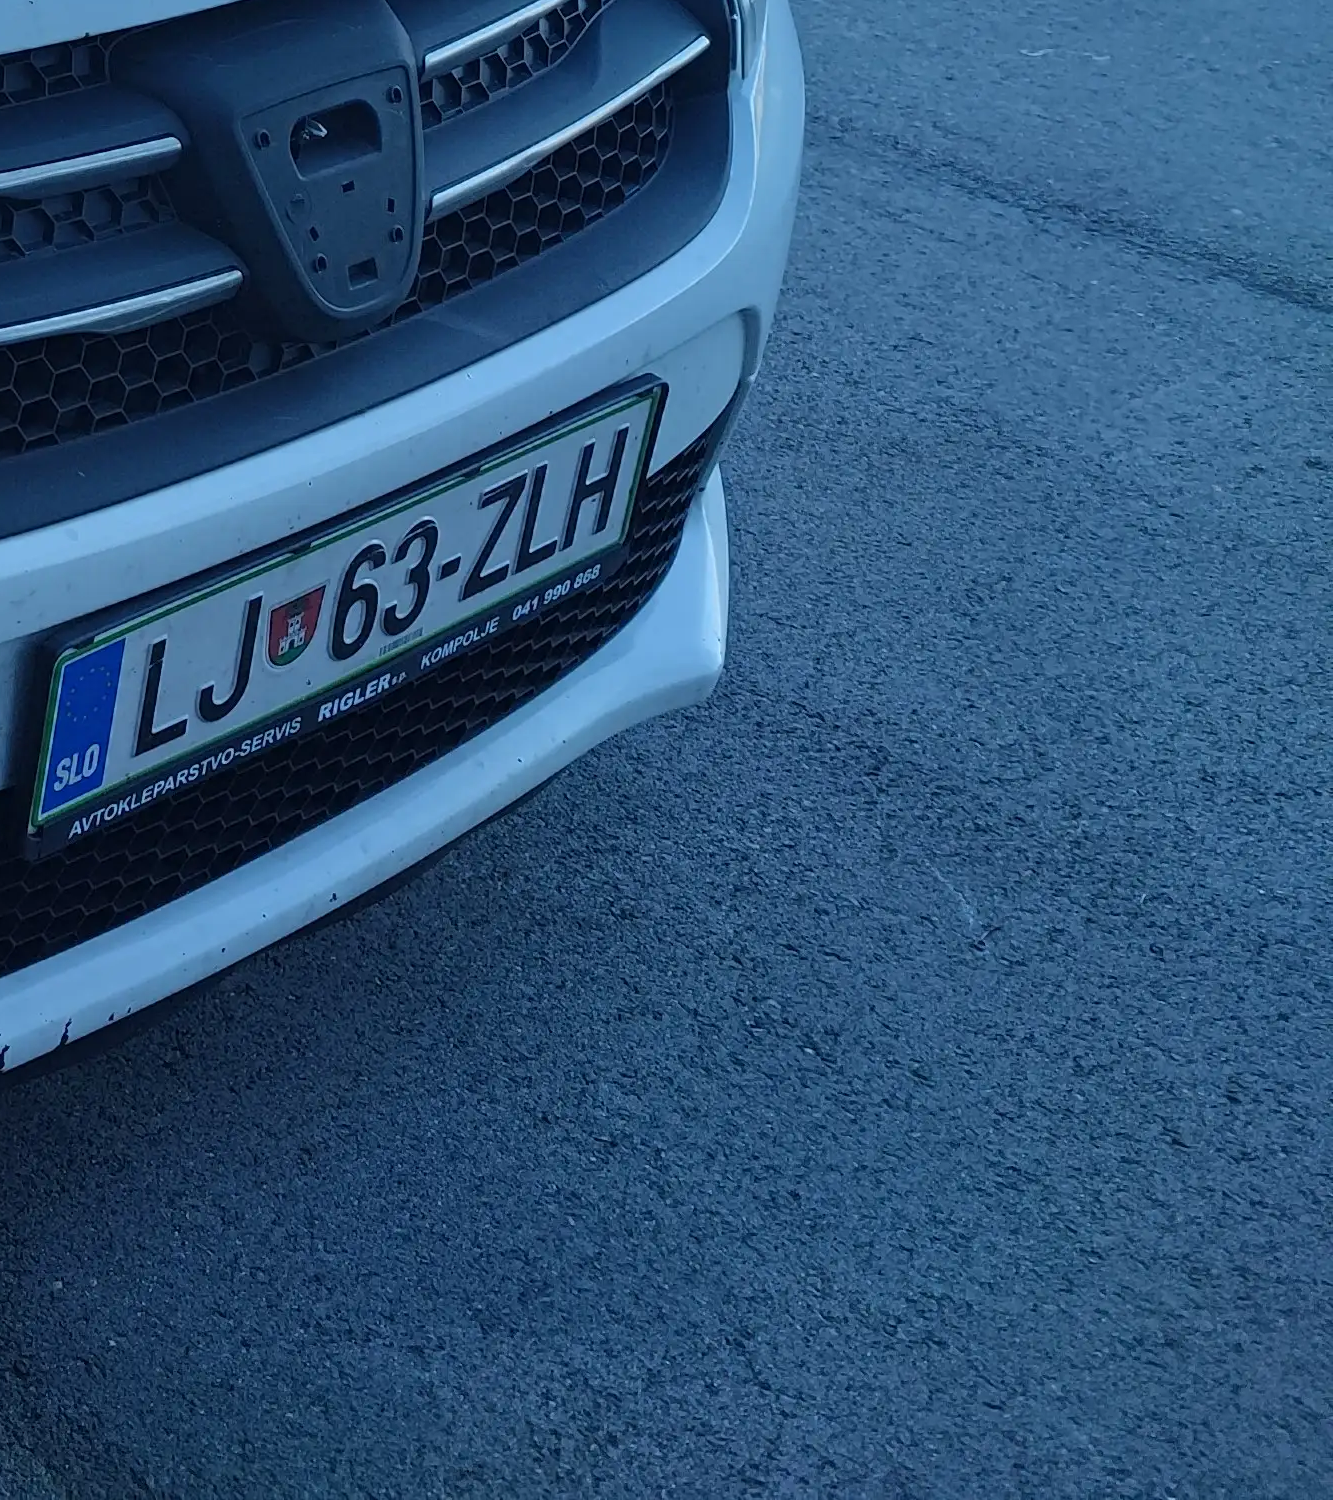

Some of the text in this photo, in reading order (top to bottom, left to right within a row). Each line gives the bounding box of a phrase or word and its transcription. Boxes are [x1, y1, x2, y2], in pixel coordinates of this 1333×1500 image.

[68, 716, 303, 840] AVTOKLEPARSTVO-SERVIS
[317, 672, 392, 722] RIGLER
[419, 615, 501, 670] KOMPOLJE
[511, 595, 540, 622] 041
[542, 578, 571, 606] 990
[573, 563, 602, 589] 868
[132, 422, 631, 758] LJ 63-ZLH
[53, 743, 101, 793] SLO
